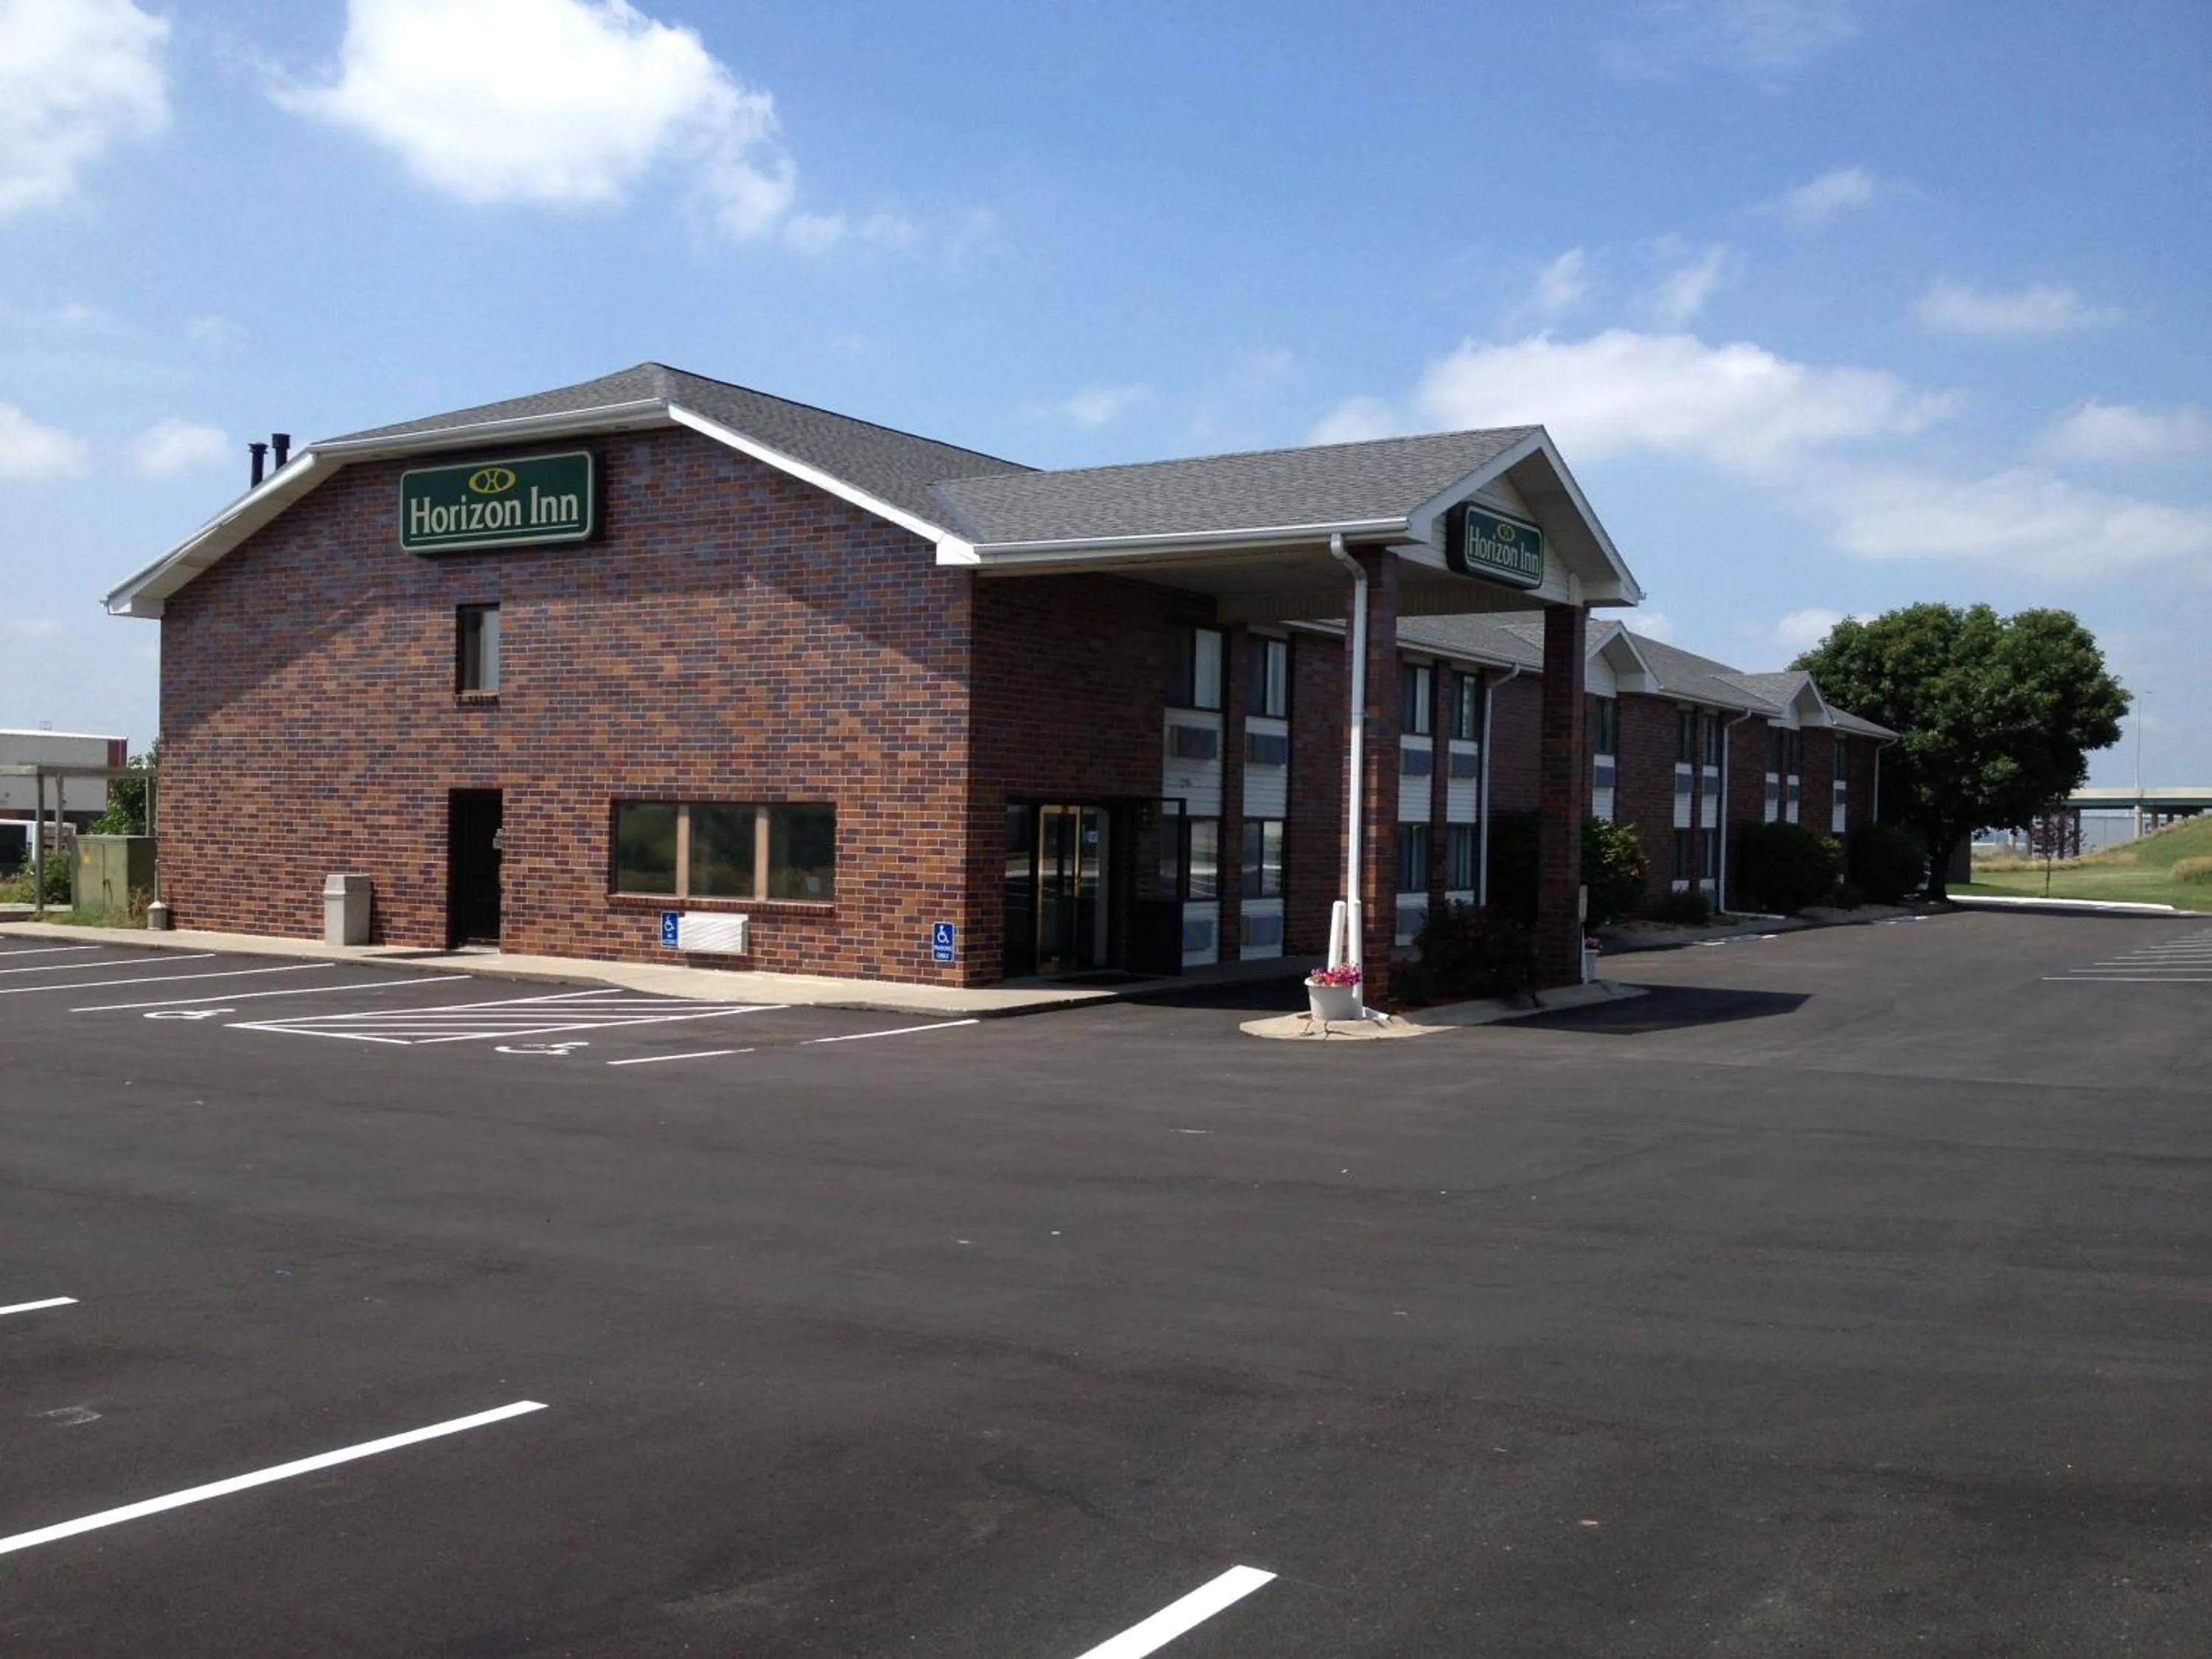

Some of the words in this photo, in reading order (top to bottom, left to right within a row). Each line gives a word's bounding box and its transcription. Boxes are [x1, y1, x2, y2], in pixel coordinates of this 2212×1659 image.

[410, 495, 521, 535] Horizon
[530, 486, 579, 524] Inn
[1470, 524, 1519, 568] Horizon
[1520, 542, 1540, 574] Inn
